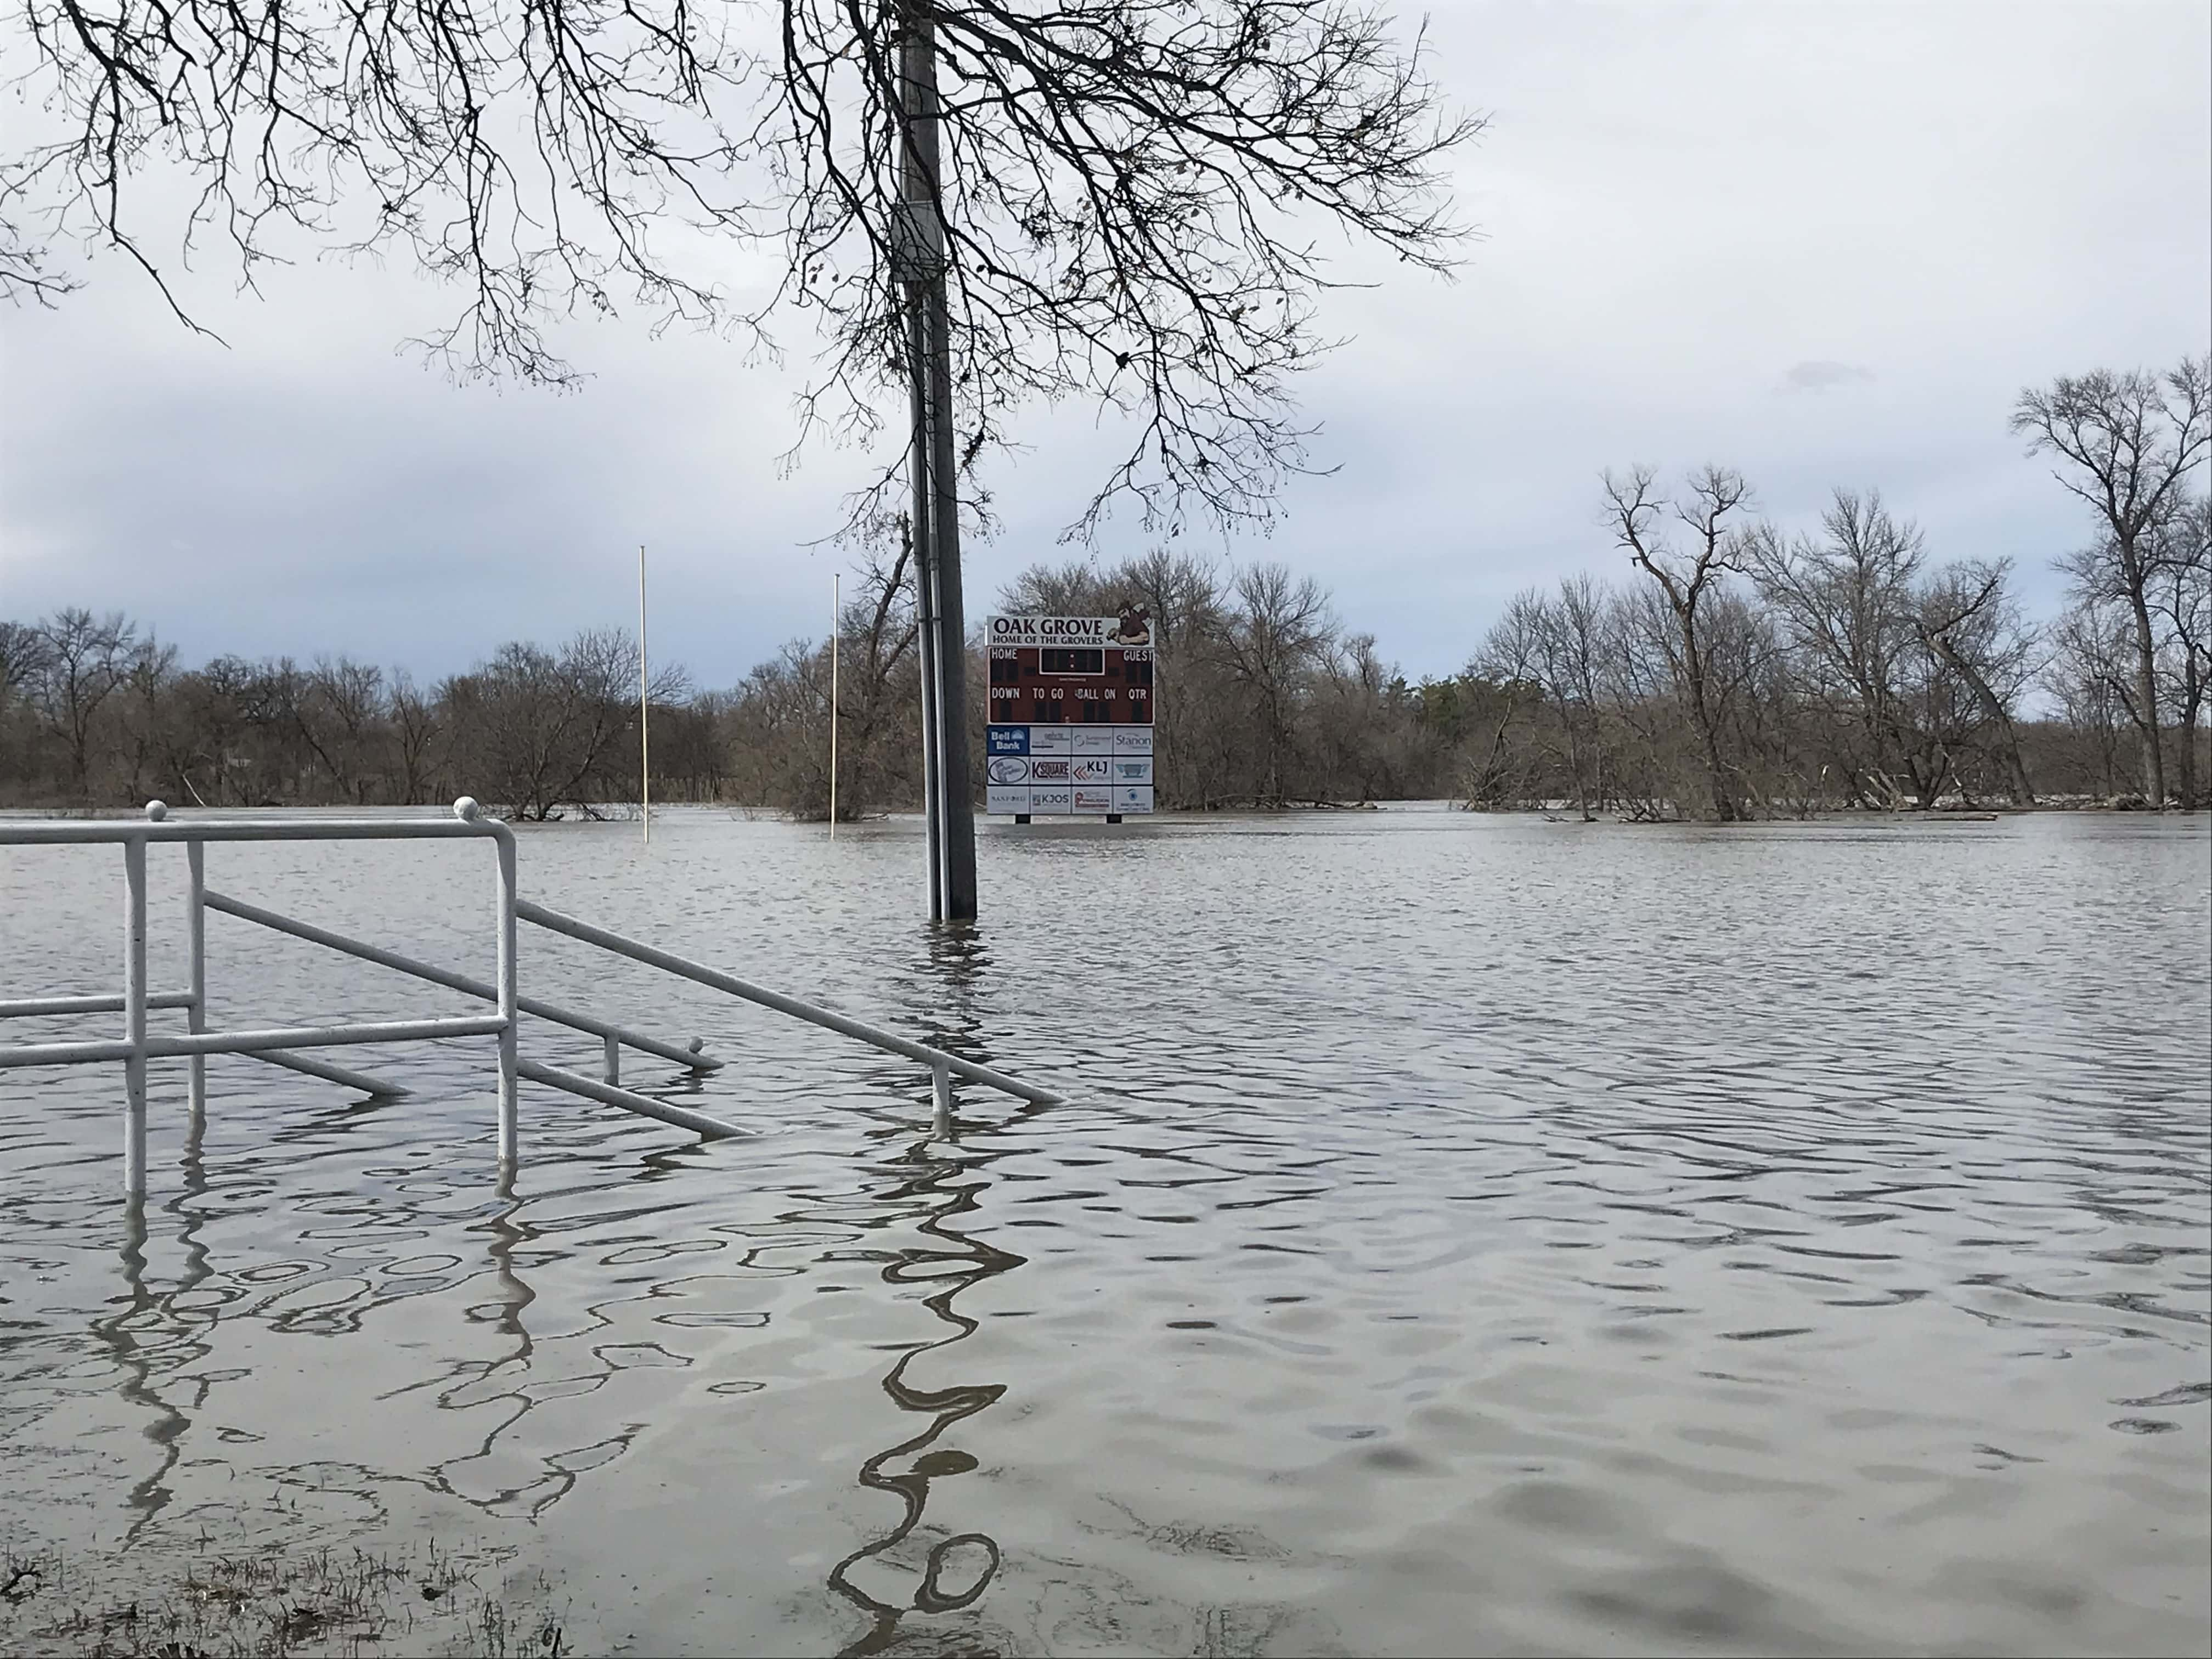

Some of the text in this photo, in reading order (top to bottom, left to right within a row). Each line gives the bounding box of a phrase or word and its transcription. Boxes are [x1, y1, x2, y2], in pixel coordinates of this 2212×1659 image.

[994, 618, 1103, 635] OAK GROVE
[993, 635, 1103, 645] HOME OF THE GROVERS
[991, 648, 1018, 659] HOME
[1124, 650, 1153, 662] GUEST
[991, 687, 1020, 699] DOWN
[1032, 687, 1064, 699] TO GO
[1104, 688, 1116, 699] ON
[991, 731, 1010, 741] Bell
[996, 741, 1020, 750] Bank
[1087, 761, 1107, 774] KLJ
[1042, 794, 1069, 804] KJOS
